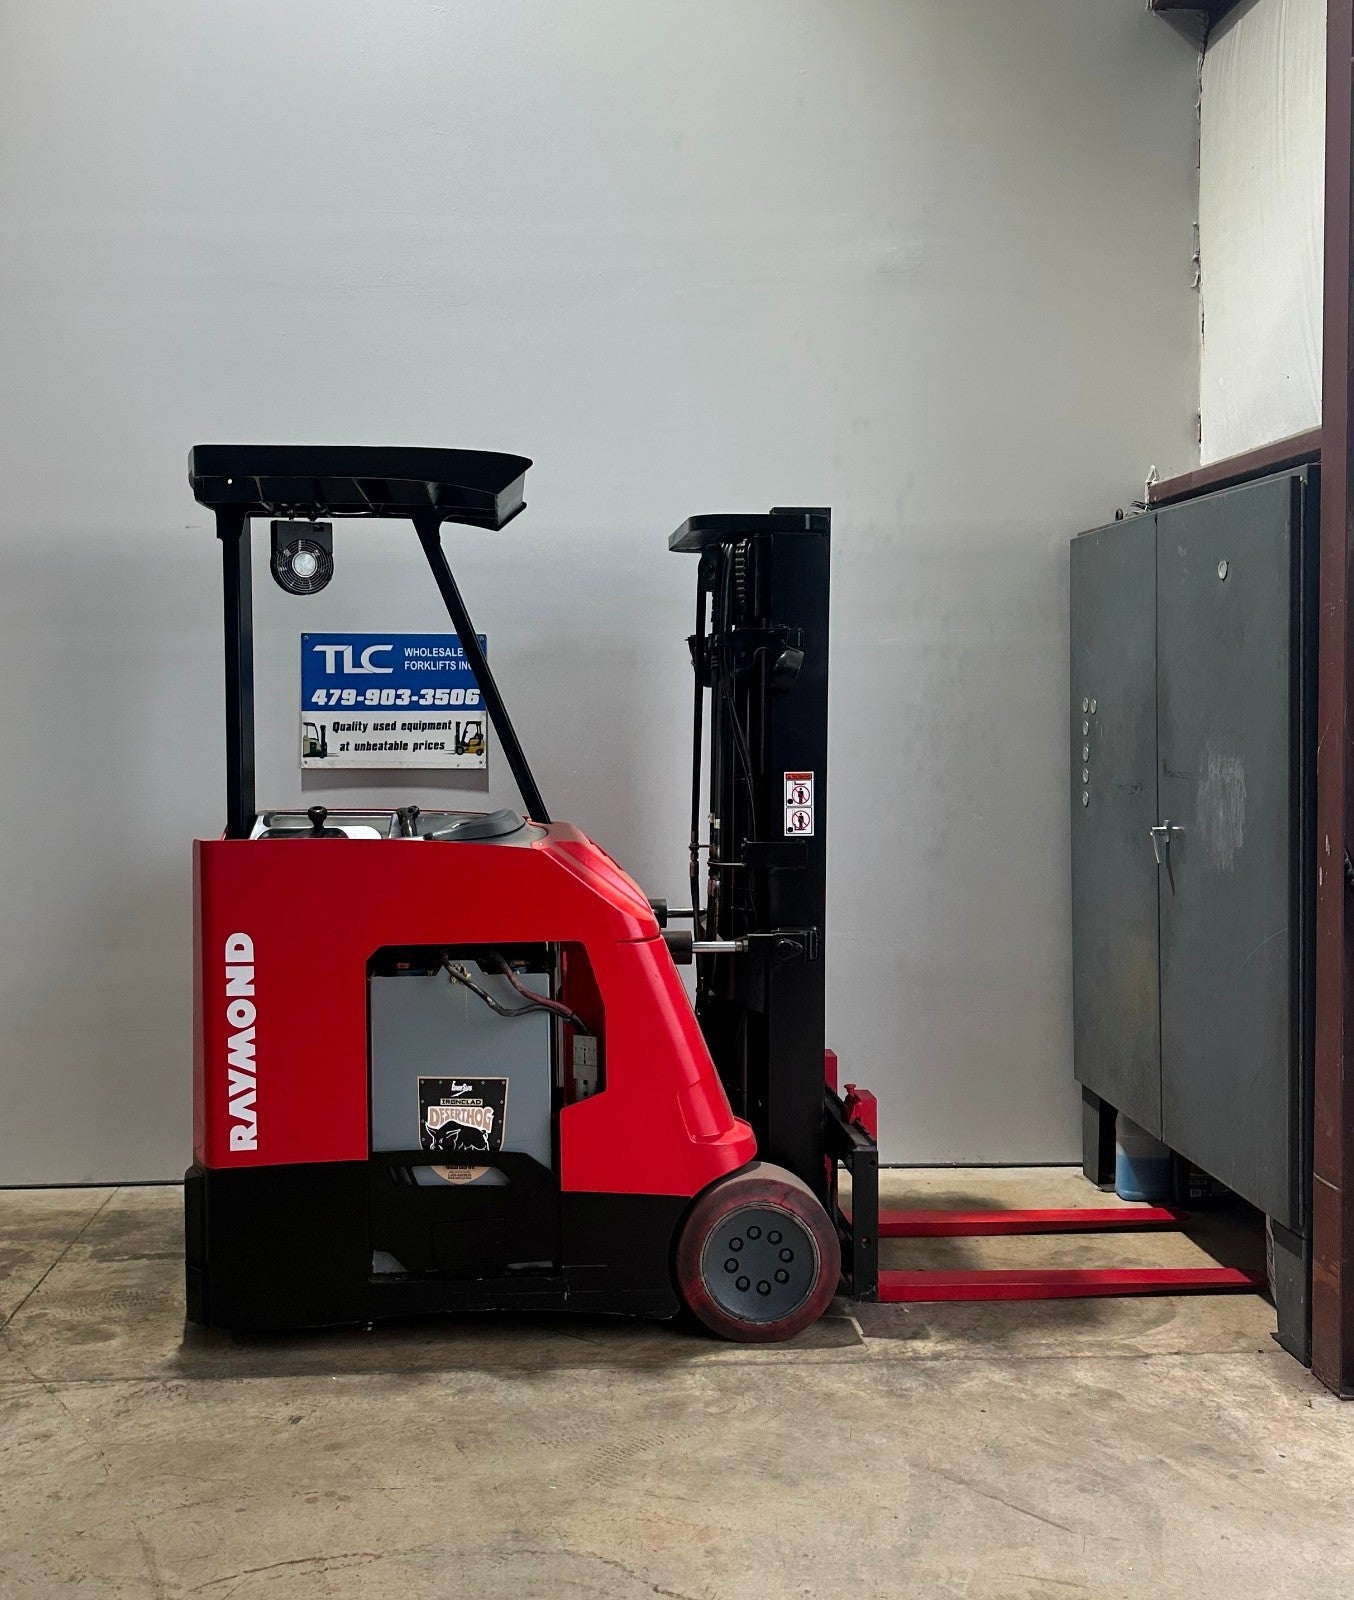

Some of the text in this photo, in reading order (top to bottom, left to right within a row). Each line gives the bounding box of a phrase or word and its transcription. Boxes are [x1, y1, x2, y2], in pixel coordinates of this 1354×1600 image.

[312, 644, 394, 674] TLC
[404, 647, 464, 657] WHOLESALE
[404, 660, 457, 671] FORKLIFTS
[311, 688, 480, 706] 479-903-3506
[332, 720, 452, 733] Quality used equipment
[339, 740, 446, 752] at unbeatable prices
[224, 932, 258, 1151] RAYMOND
[428, 1107, 494, 1132] DESERTHOG
